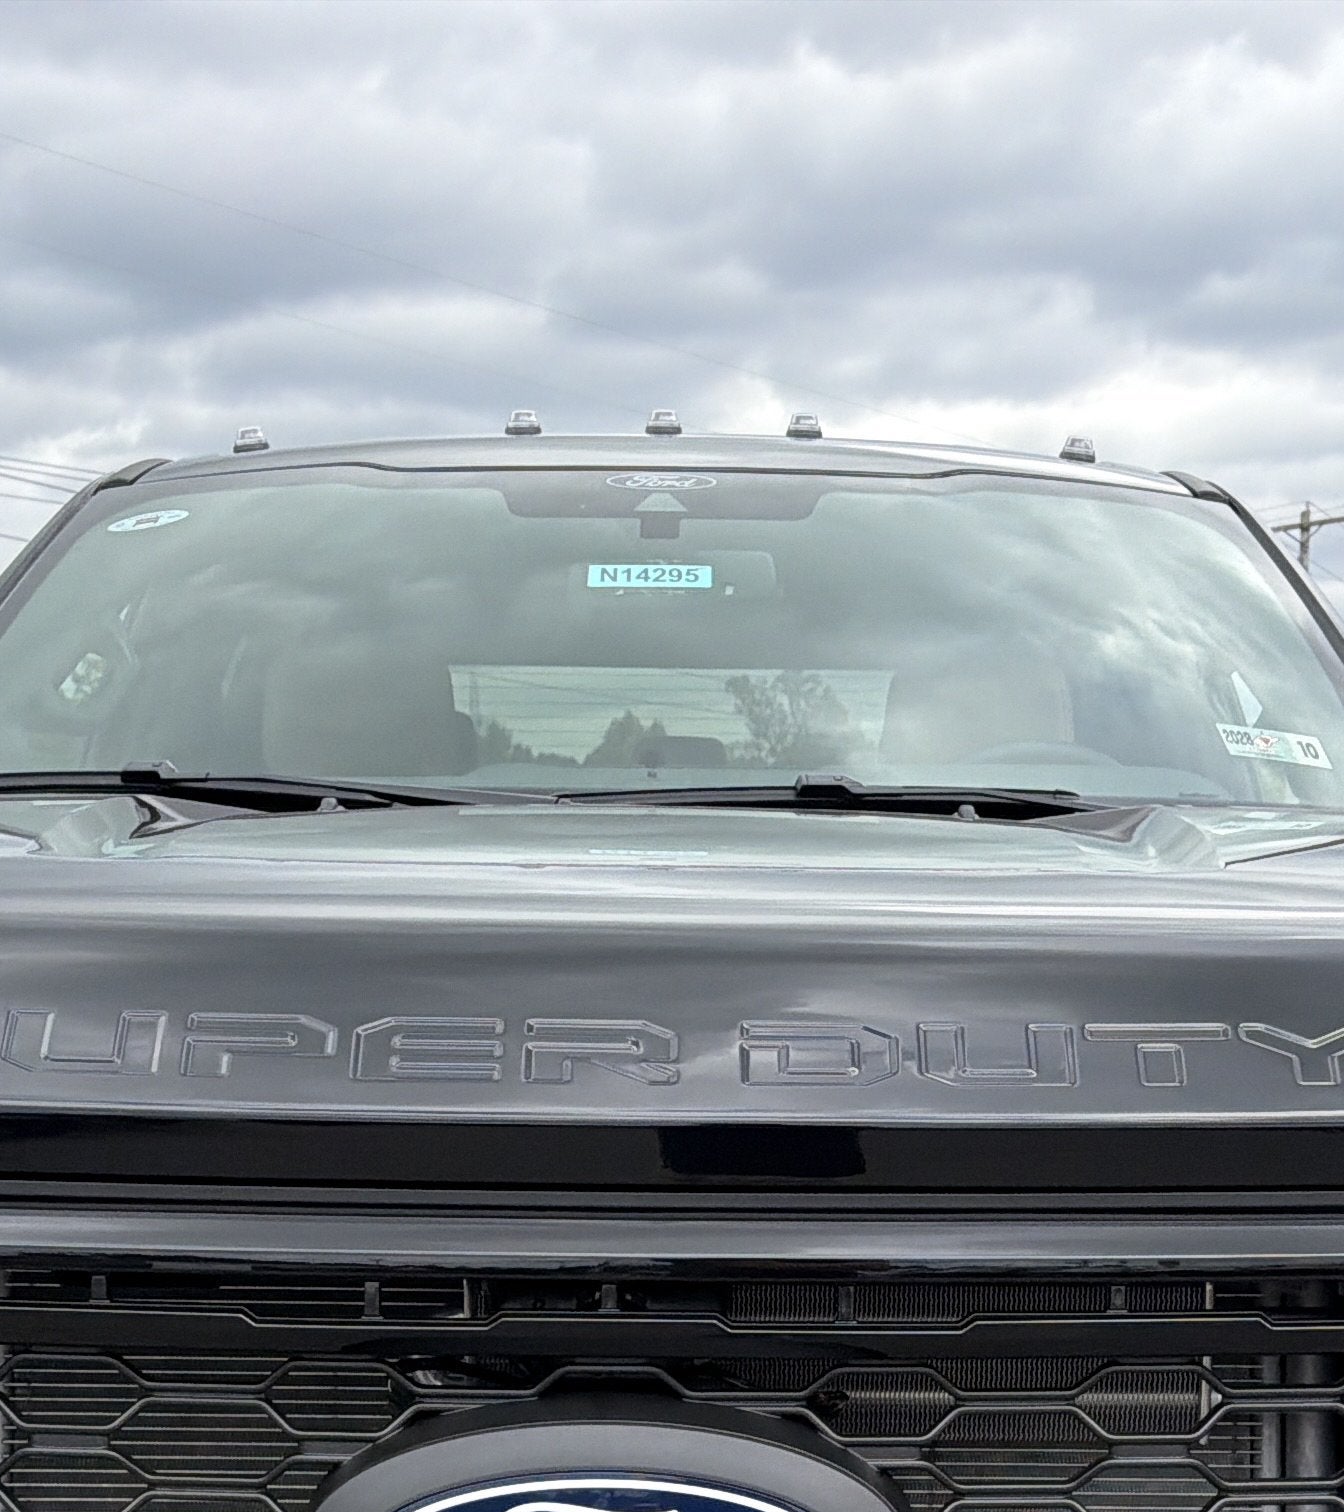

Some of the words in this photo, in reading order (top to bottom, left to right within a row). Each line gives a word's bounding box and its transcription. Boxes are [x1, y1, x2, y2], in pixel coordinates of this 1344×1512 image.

[625, 475, 698, 488] Ford
[600, 567, 700, 583] N14295
[1297, 740, 1320, 760] 10
